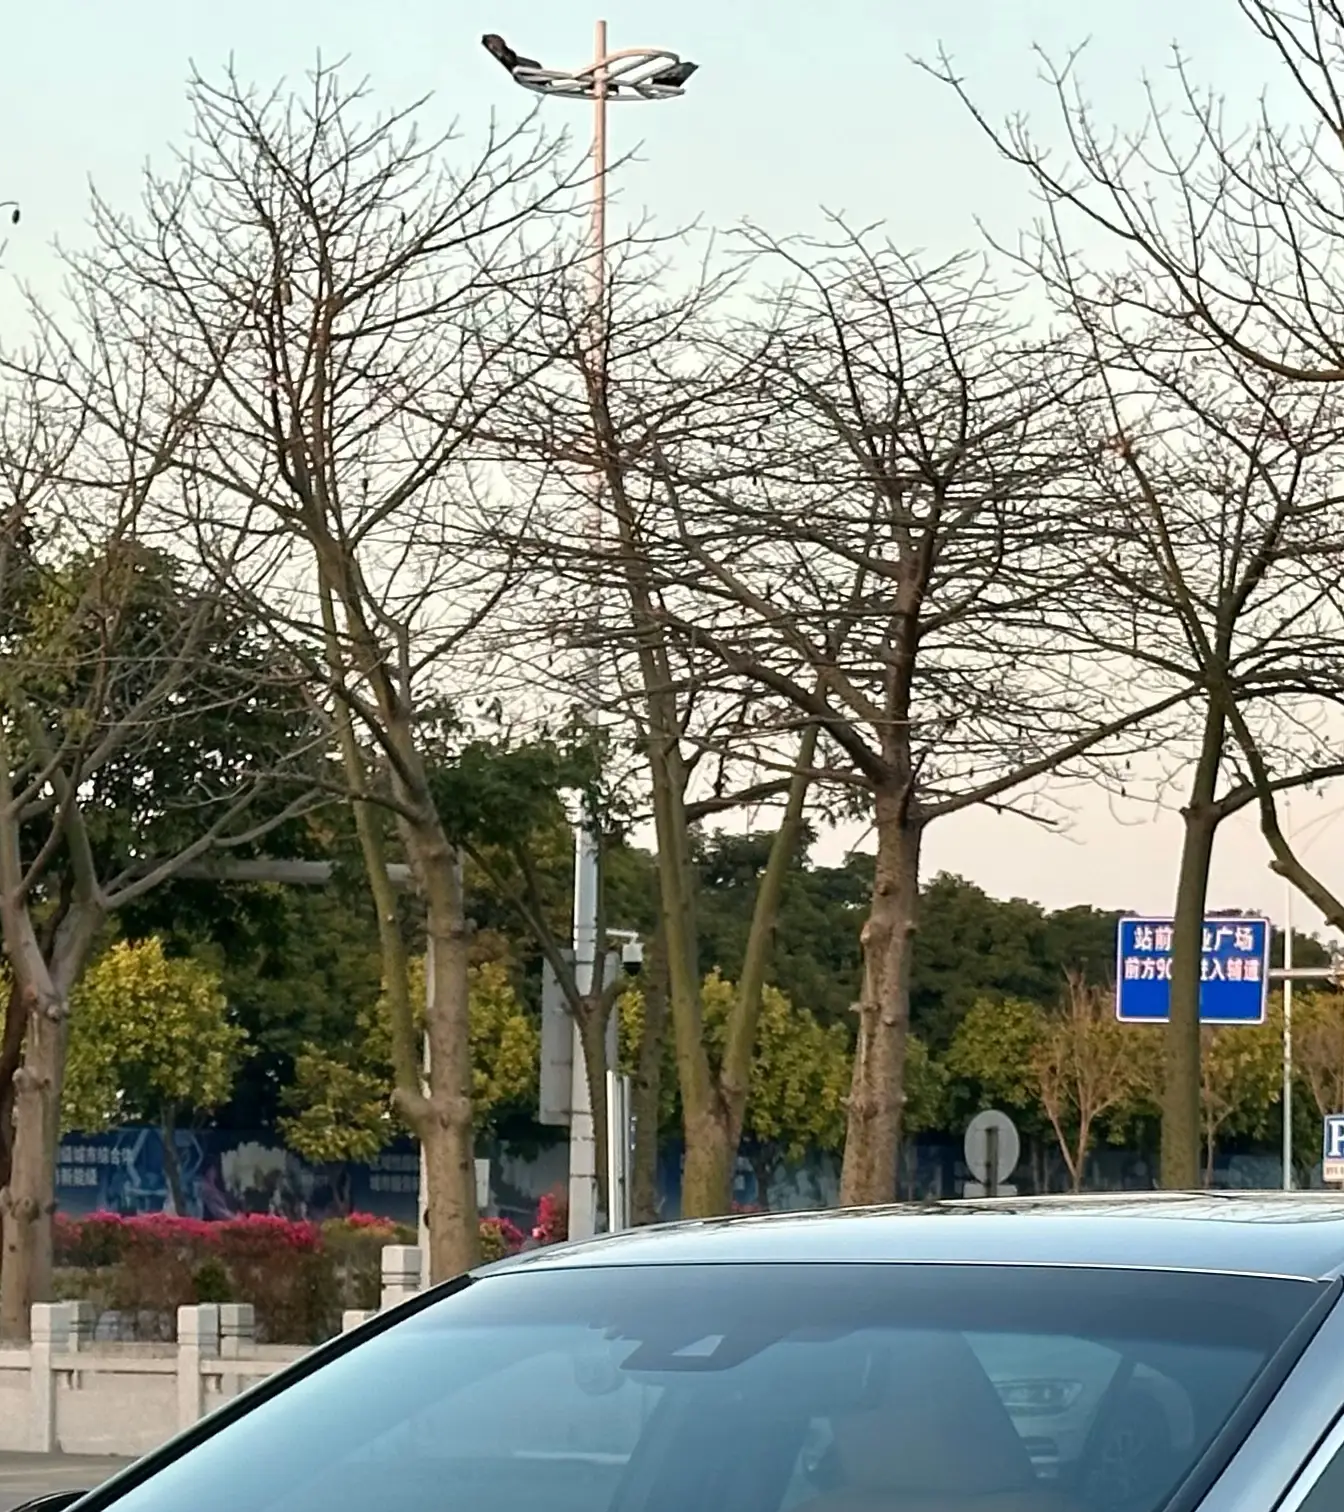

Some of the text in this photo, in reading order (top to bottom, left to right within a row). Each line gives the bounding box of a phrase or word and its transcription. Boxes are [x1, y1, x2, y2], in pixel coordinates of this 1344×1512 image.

[1133, 925, 1254, 952] 站前业广场
